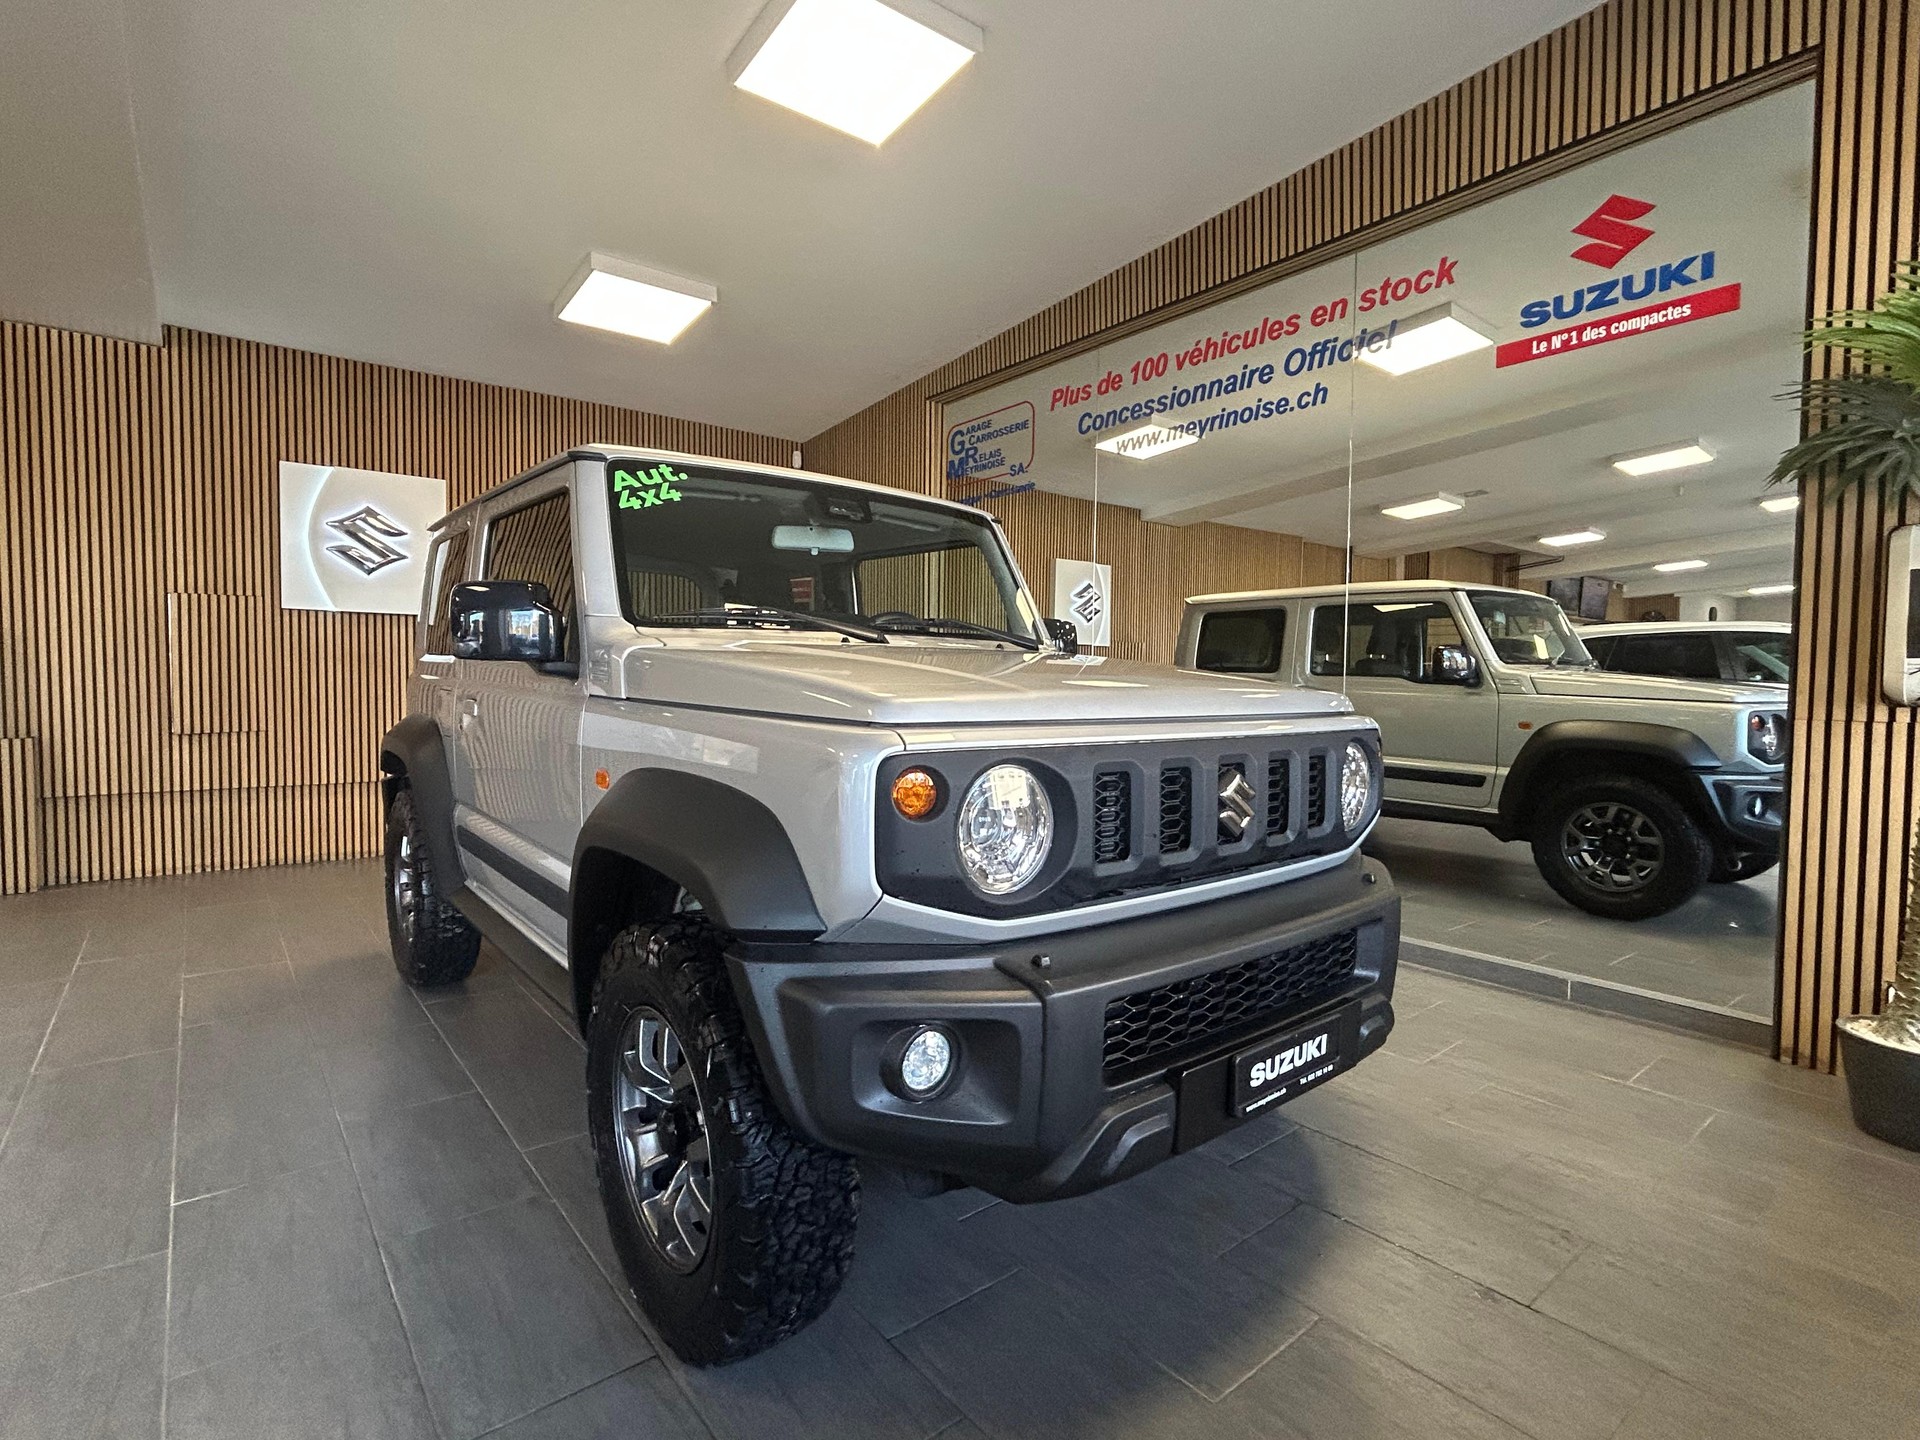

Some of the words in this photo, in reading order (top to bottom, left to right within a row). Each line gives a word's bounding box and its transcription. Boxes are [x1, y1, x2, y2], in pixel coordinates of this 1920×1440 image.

[1520, 250, 1715, 329] SUZUKI
[1050, 383, 1092, 411] Plus
[1096, 370, 1123, 396] de
[1130, 352, 1169, 385] 100
[1175, 313, 1302, 371] véhicules
[1310, 297, 1349, 327] en
[1358, 256, 1459, 312] stock
[1531, 340, 1548, 355] Le
[1581, 326, 1607, 342] des
[1610, 303, 1692, 335] compactes
[1077, 363, 1275, 435] Concessionnaire
[1283, 319, 1398, 377] Officiel
[968, 419, 1030, 446] CARROSSERIE
[1116, 382, 1329, 455] www.meyrinoise.ch
[614, 463, 689, 492] Aut.
[964, 446, 1002, 467] RELAIS
[1249, 1033, 1328, 1088] SUZUKI
